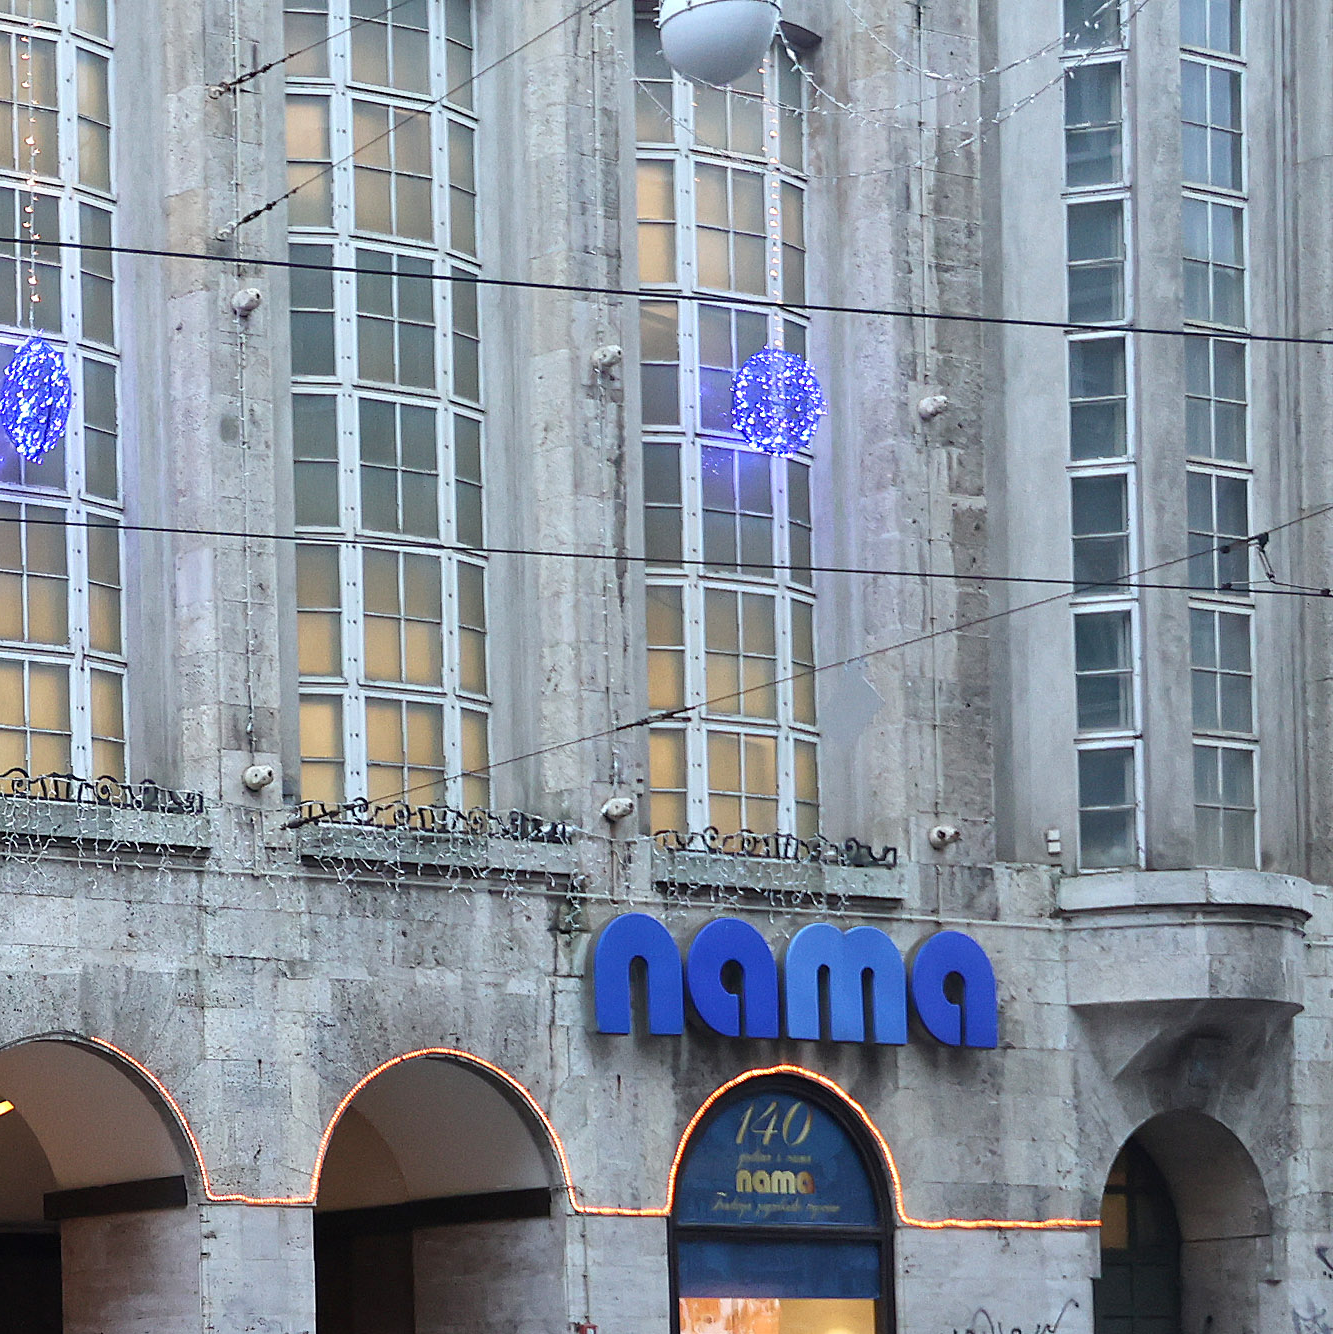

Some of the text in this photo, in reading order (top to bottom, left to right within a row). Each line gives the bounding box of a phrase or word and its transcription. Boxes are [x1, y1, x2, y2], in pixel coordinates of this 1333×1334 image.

[594, 913, 998, 1049] nama
[736, 1102, 813, 1146] 140
[736, 1169, 815, 1194] nama
